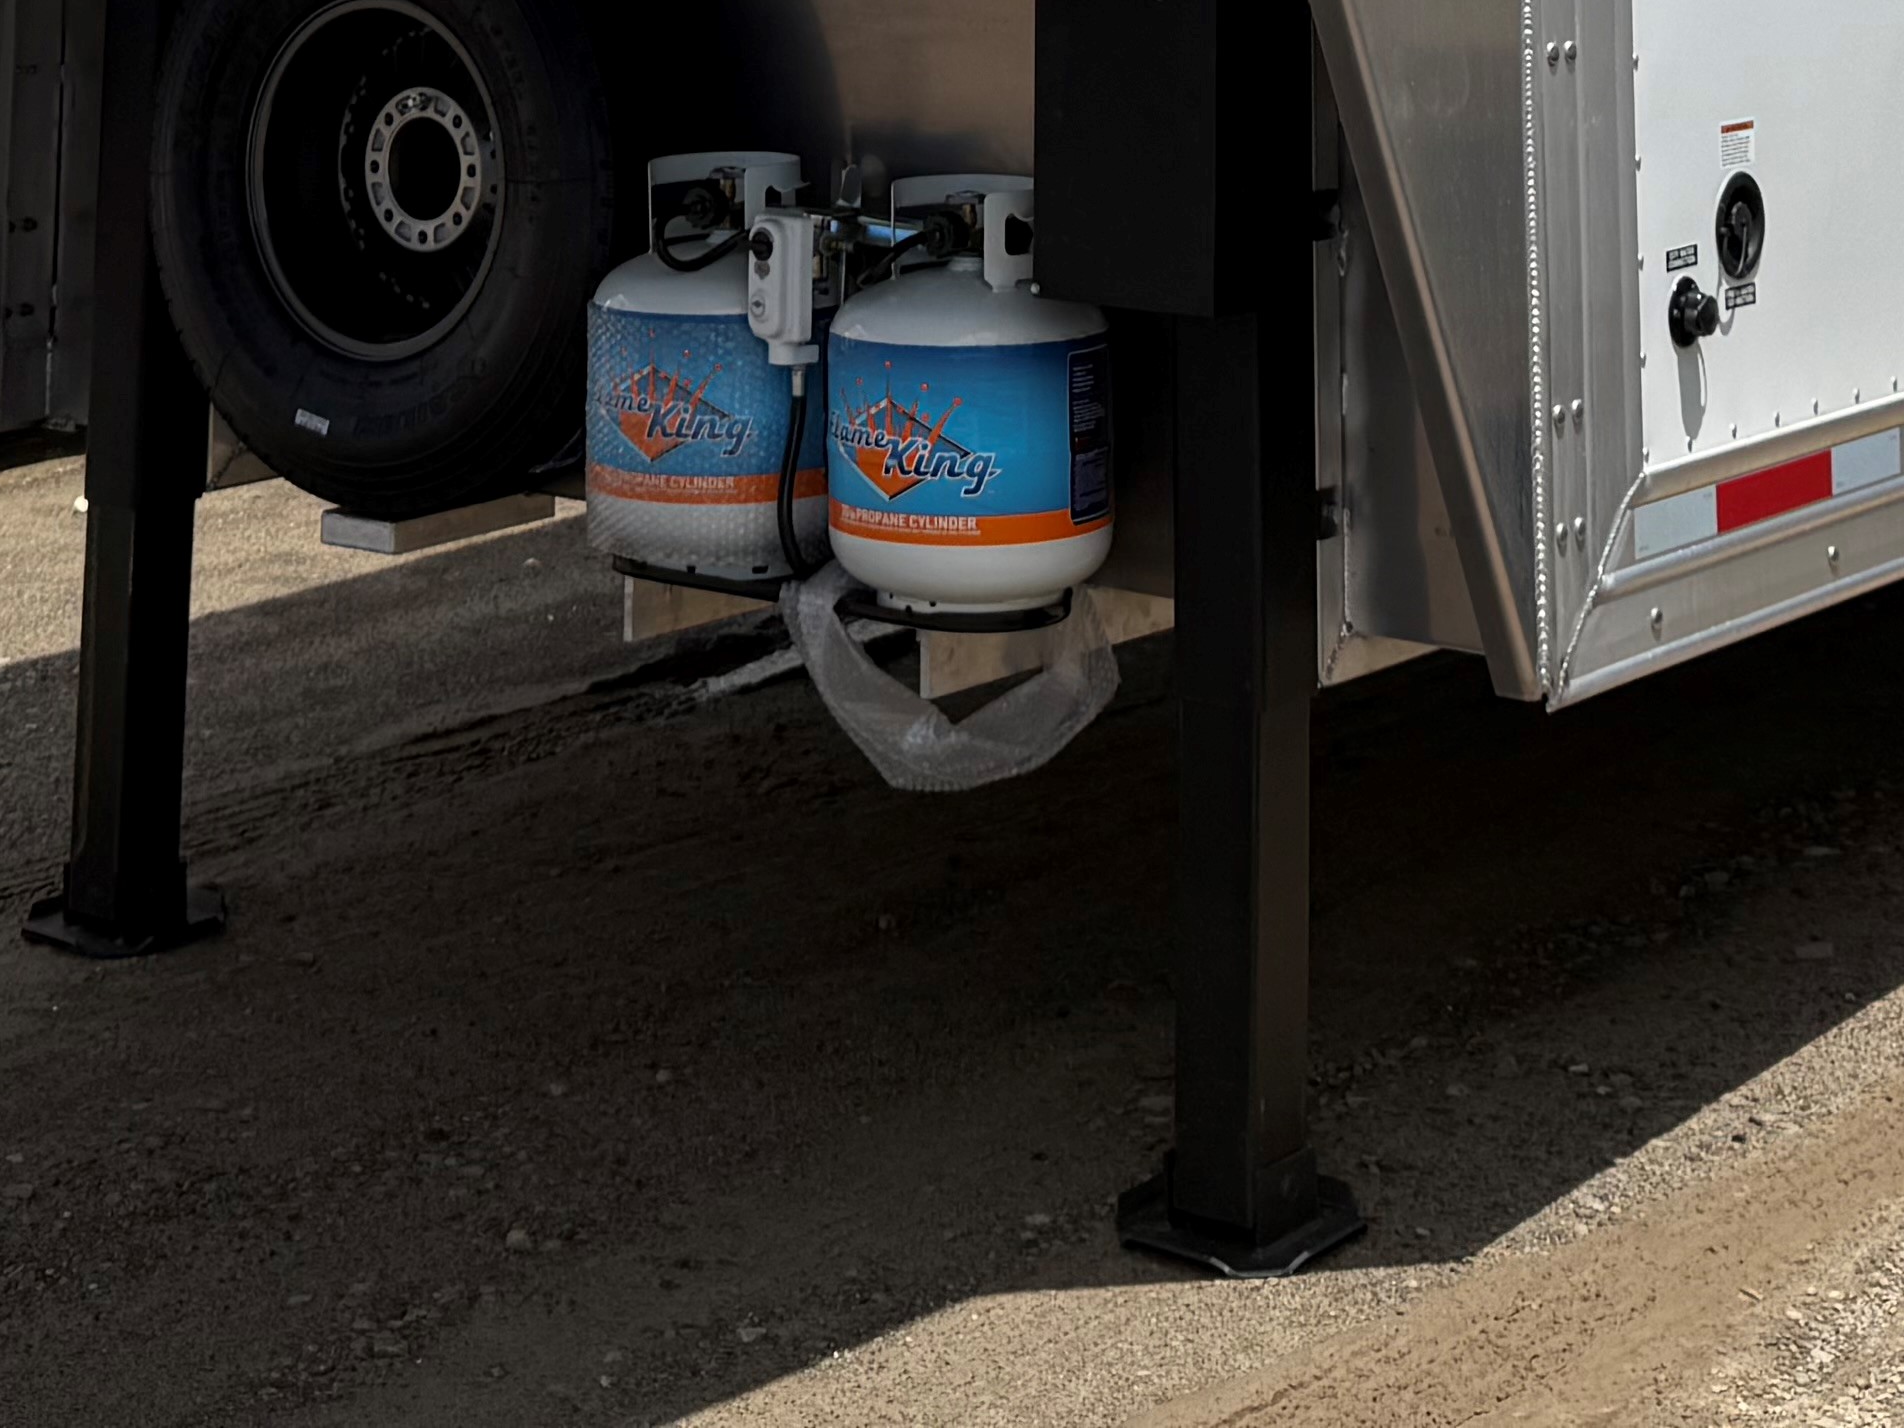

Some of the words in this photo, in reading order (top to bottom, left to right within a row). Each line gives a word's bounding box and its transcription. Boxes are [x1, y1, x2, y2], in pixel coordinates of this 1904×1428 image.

[646, 402, 754, 458] King
[668, 474, 735, 489] CYLINDER
[882, 435, 1003, 498] King
[856, 506, 907, 528] PROPANE
[908, 514, 978, 531] CYLINDER
